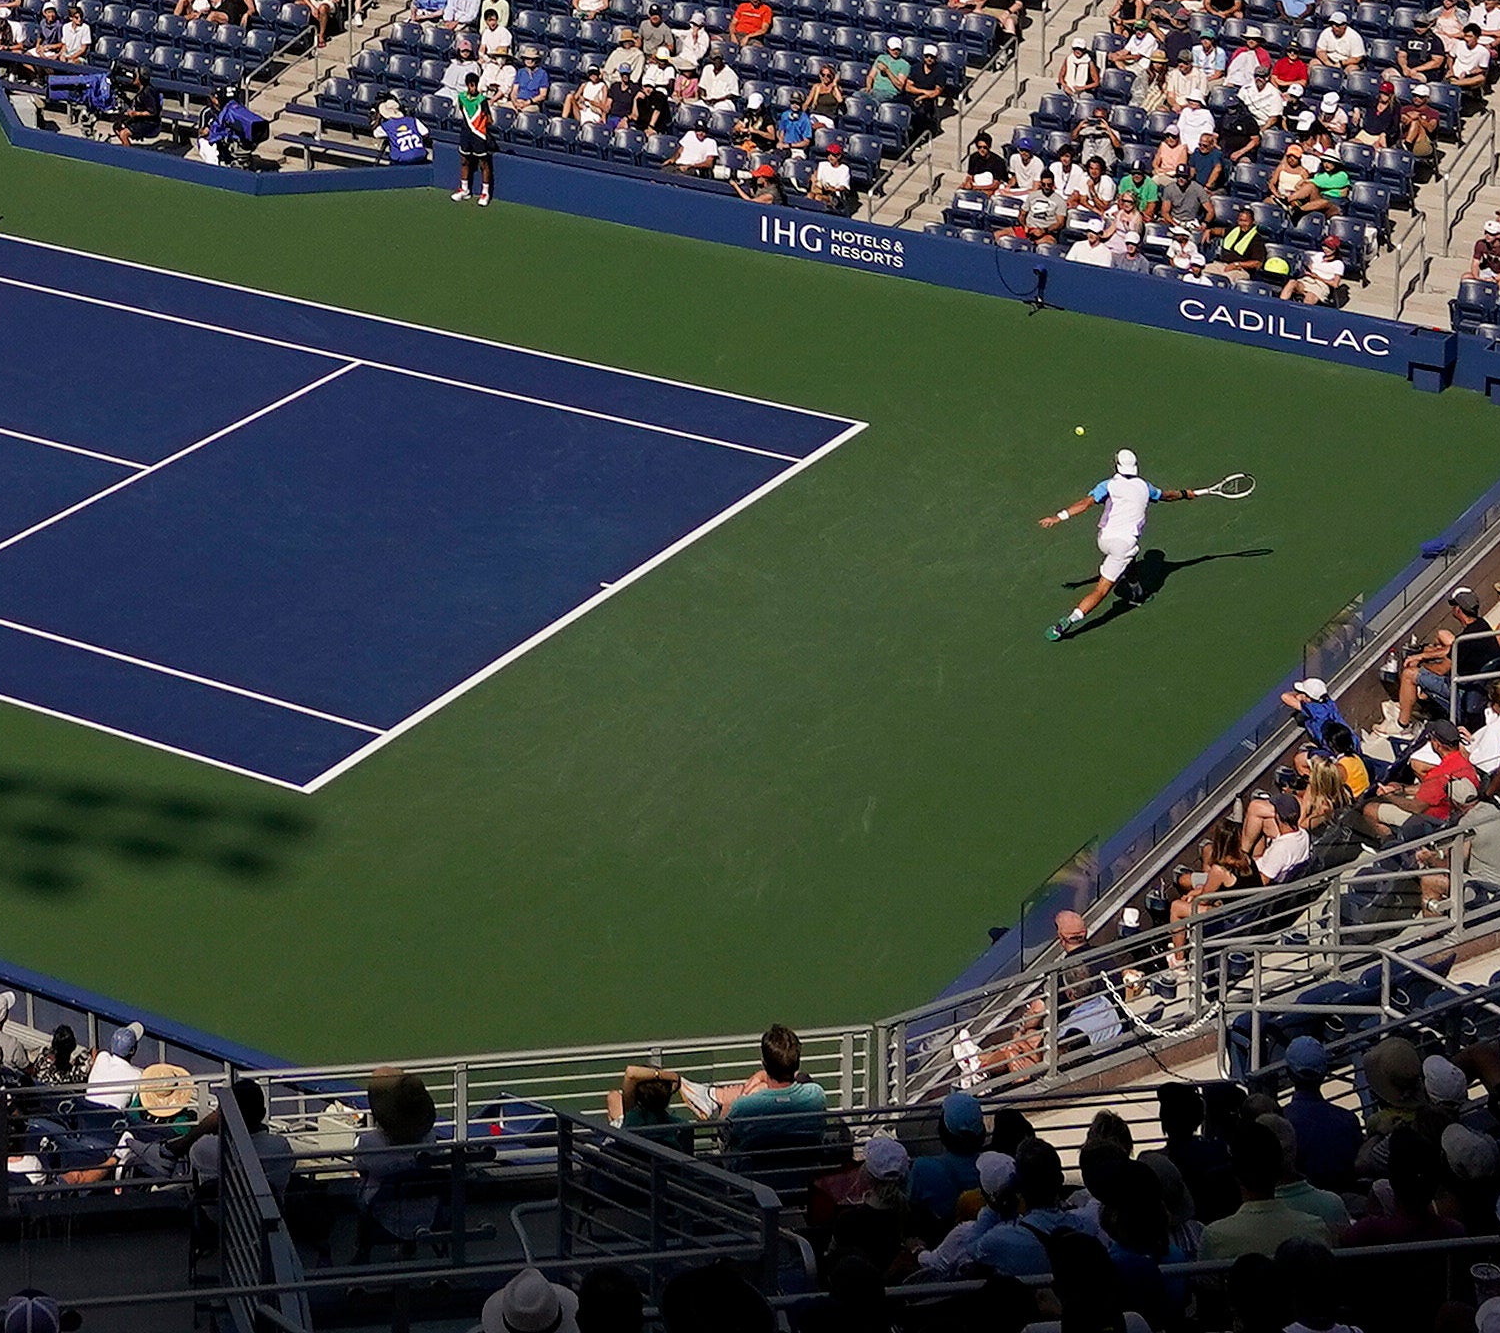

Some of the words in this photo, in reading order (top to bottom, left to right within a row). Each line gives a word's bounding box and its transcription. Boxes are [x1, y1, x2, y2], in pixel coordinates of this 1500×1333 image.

[397, 135, 422, 152] 272
[760, 215, 824, 252] IHG
[830, 230, 891, 251] HOTELS
[892, 240, 904, 254] &
[829, 244, 904, 269] RESORTS
[1179, 299, 1390, 357] CADILLAC
